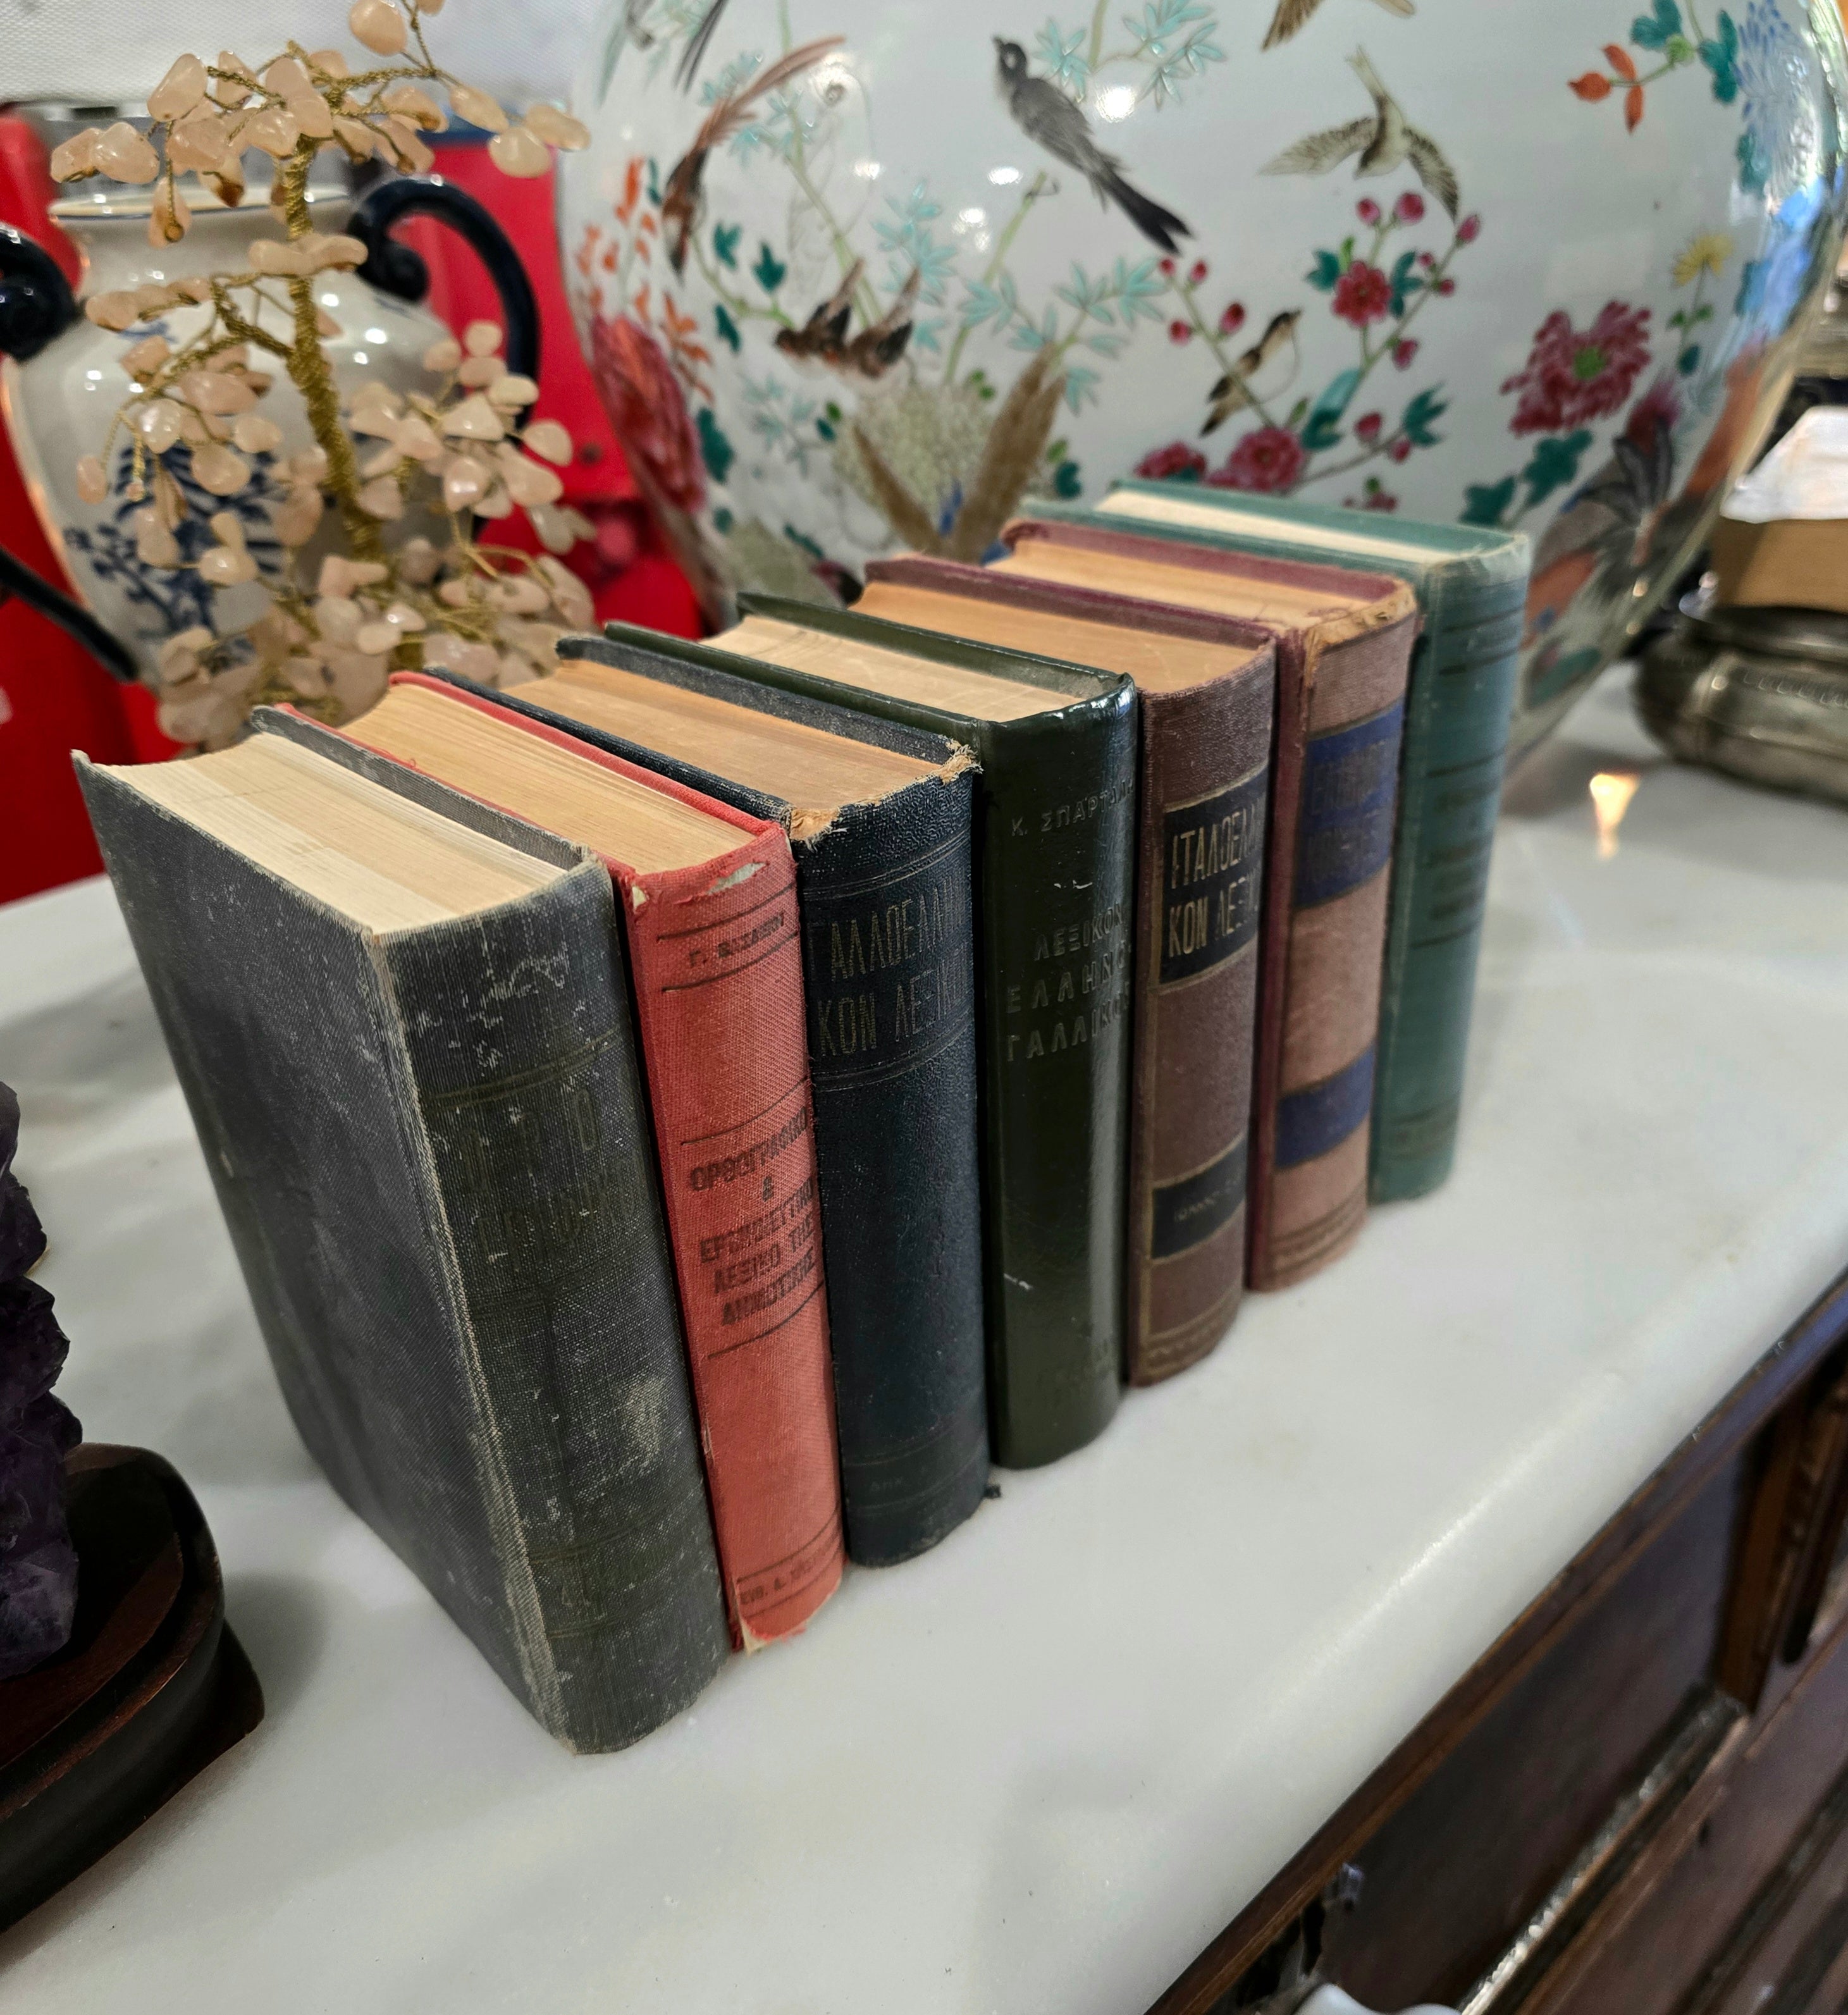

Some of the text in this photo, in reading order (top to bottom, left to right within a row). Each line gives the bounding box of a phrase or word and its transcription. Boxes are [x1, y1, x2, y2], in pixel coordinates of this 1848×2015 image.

[1033, 901, 1123, 961] ΛΕΞΙΚΟΝ
[1169, 896, 1209, 958] ΚΟΝ
[817, 992, 877, 1057] ΚΟΝ
[788, 1212, 815, 1254] ΤΗΣ
